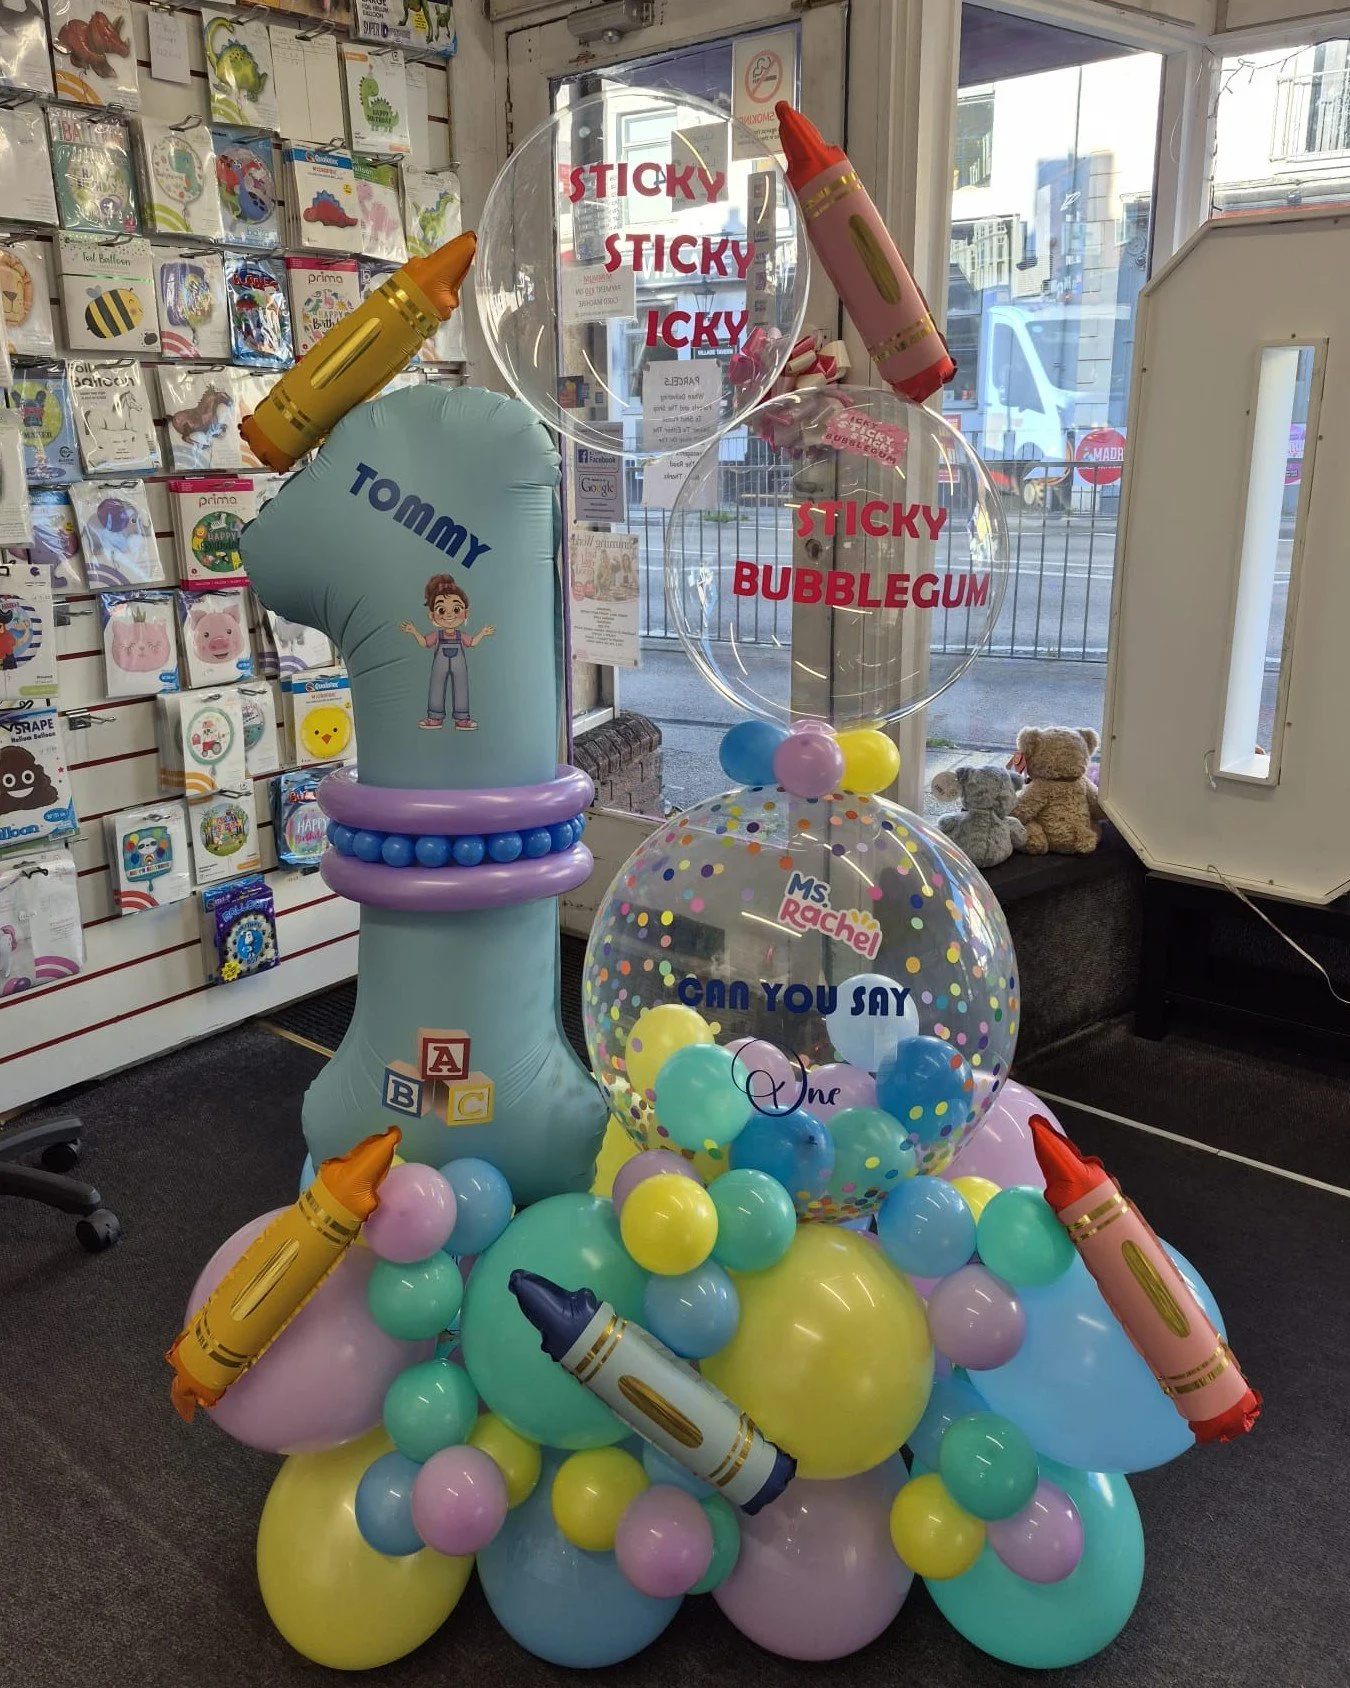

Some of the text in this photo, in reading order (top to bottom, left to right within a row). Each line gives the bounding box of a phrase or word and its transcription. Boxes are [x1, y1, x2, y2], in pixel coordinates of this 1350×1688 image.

[569, 162, 726, 204] STICKY
[604, 233, 756, 279] STICKY
[308, 272, 343, 284] prima
[645, 310, 750, 348] ICKY
[850, 416, 878, 429] ICKY
[589, 456, 616, 464] Facebook
[825, 433, 897, 465] BUBBLEGUM
[199, 493, 237, 508] prima
[581, 477, 614, 497] Google
[349, 462, 492, 569] TOMMY
[796, 501, 948, 540] STICKY
[207, 531, 238, 541] HAPPY
[733, 560, 990, 609] BUBBLEGUM
[298, 818, 331, 833] HAPPY
[780, 898, 880, 957] Rachel
[677, 977, 911, 1017] CAN YOU SAY
[428, 1045, 462, 1073] A
[731, 1039, 842, 1118] One
[389, 1079, 485, 1117] B C
